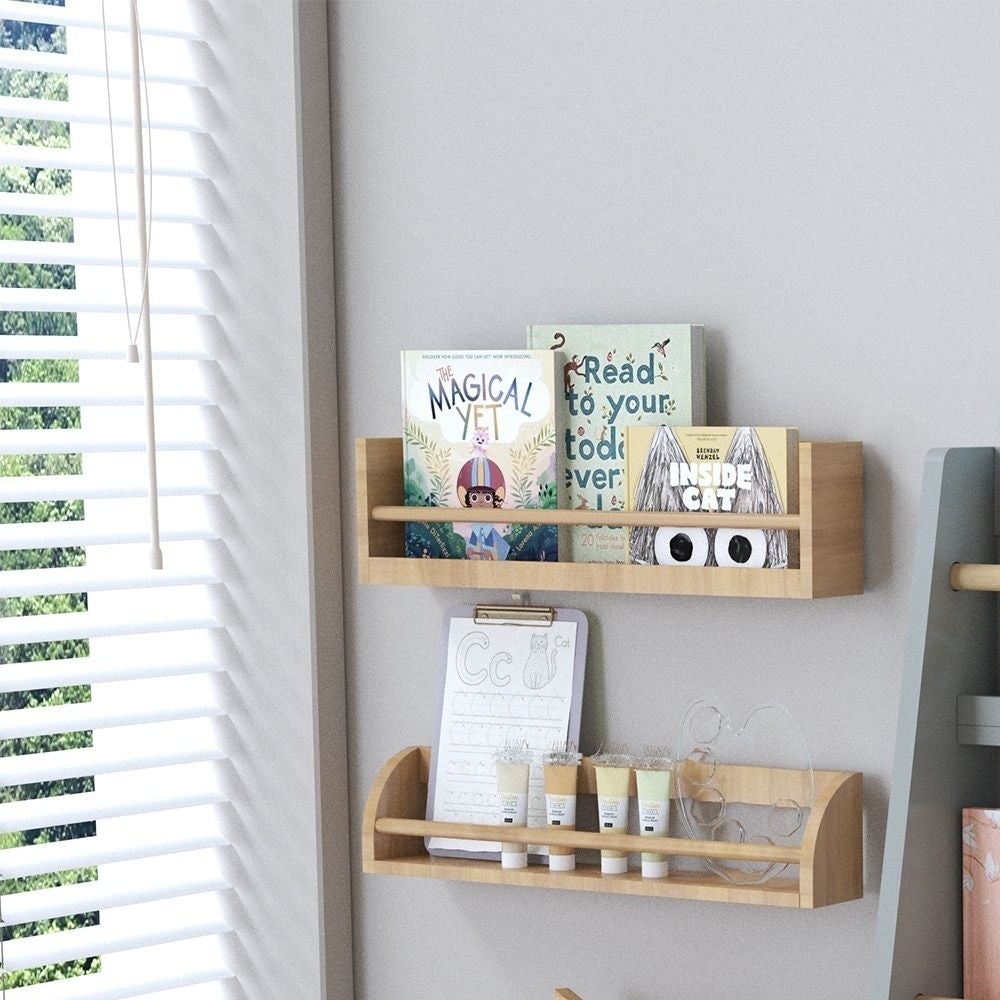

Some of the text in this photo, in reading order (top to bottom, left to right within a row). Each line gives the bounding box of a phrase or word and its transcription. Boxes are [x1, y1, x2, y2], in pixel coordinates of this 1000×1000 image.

[436, 365, 454, 383] THE
[585, 353, 655, 384] Read
[428, 373, 532, 419] MAGICAL
[565, 388, 670, 424] to your
[456, 404, 502, 440] YET
[670, 461, 752, 490] INSIDE
[682, 486, 736, 511] CAT
[554, 635, 571, 648] Cat
